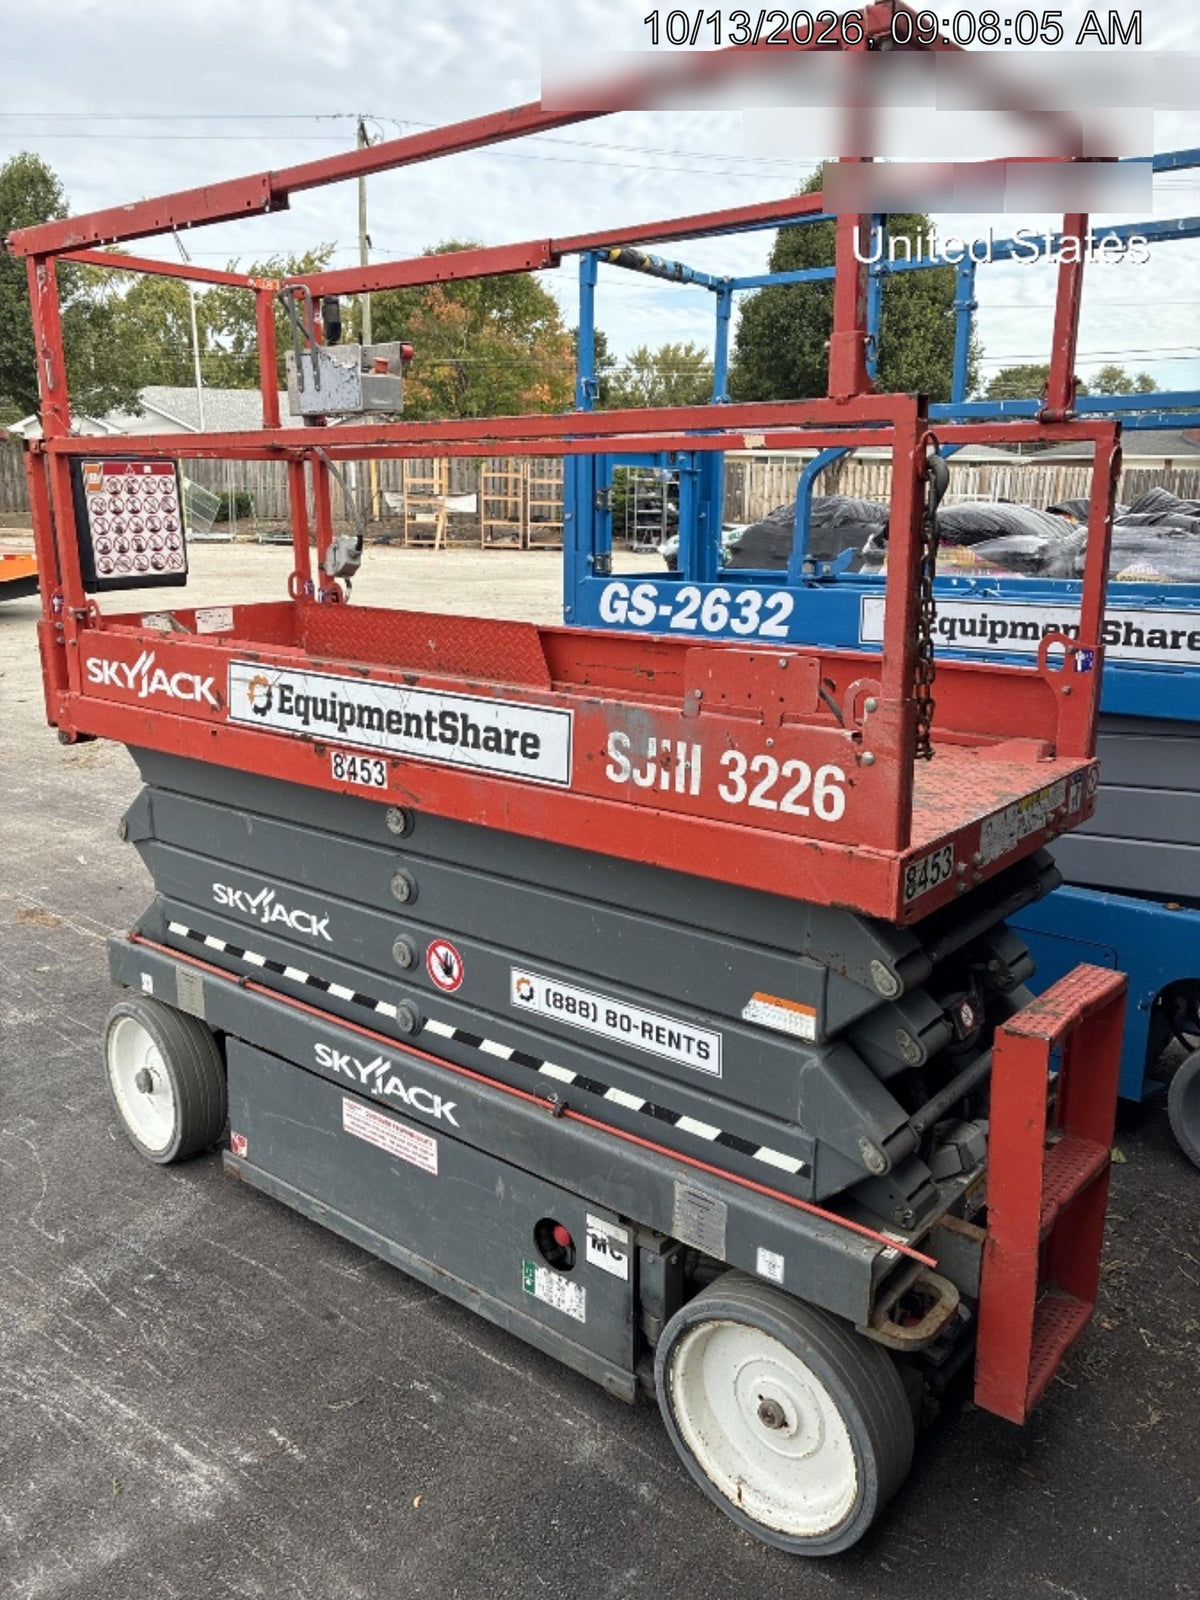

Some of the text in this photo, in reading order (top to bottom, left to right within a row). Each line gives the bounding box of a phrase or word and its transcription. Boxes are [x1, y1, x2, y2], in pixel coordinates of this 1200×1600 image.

[599, 582, 794, 637] GS-2632
[87, 650, 218, 705] SKYJACK
[278, 683, 542, 760] EquipmentShare
[332, 755, 387, 787] 8453
[717, 748, 846, 822] 3226
[905, 845, 953, 900] 8453
[212, 883, 333, 942] SKYJACK
[545, 988, 598, 1023] (888)
[605, 1009, 711, 1061] 80-RENTS
[314, 1043, 460, 1127] SKYJACK
